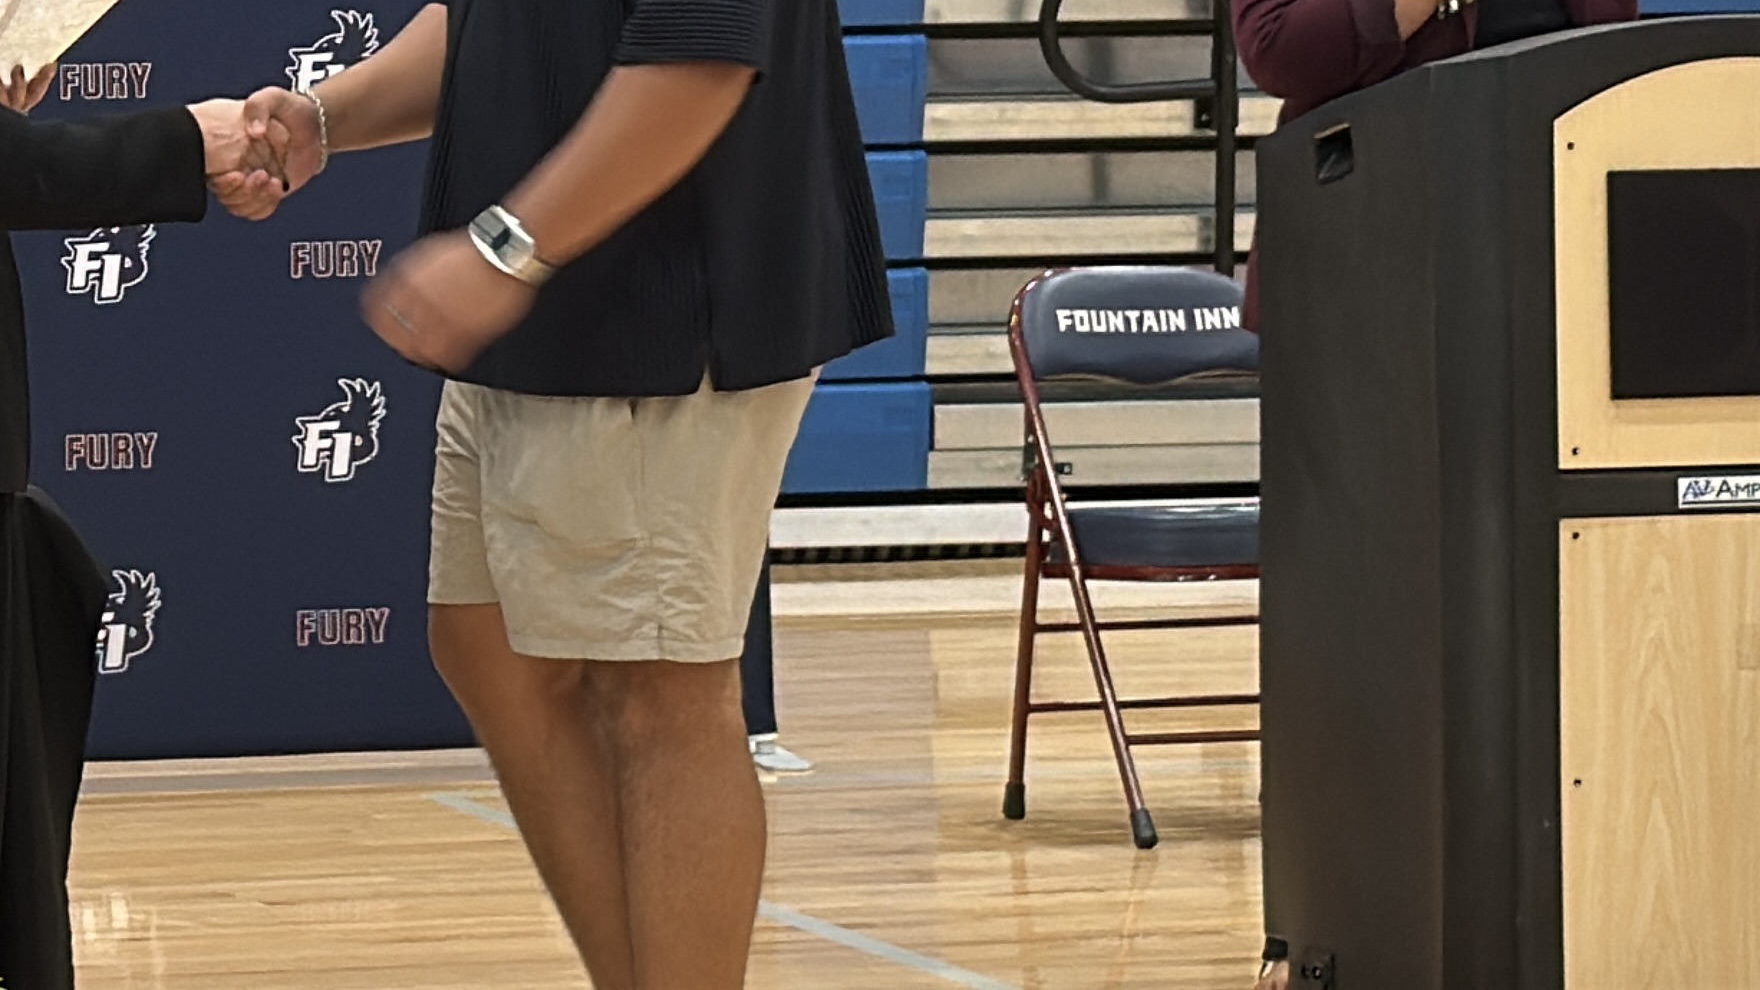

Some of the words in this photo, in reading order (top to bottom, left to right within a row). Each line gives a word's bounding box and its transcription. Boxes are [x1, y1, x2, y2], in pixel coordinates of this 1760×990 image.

[59, 62, 152, 101] FURY
[290, 240, 383, 279] FURY
[1055, 308, 1187, 333] FOUNTAIN
[1193, 306, 1241, 331] INN
[66, 432, 159, 471] FURY
[296, 608, 391, 646] FURY
